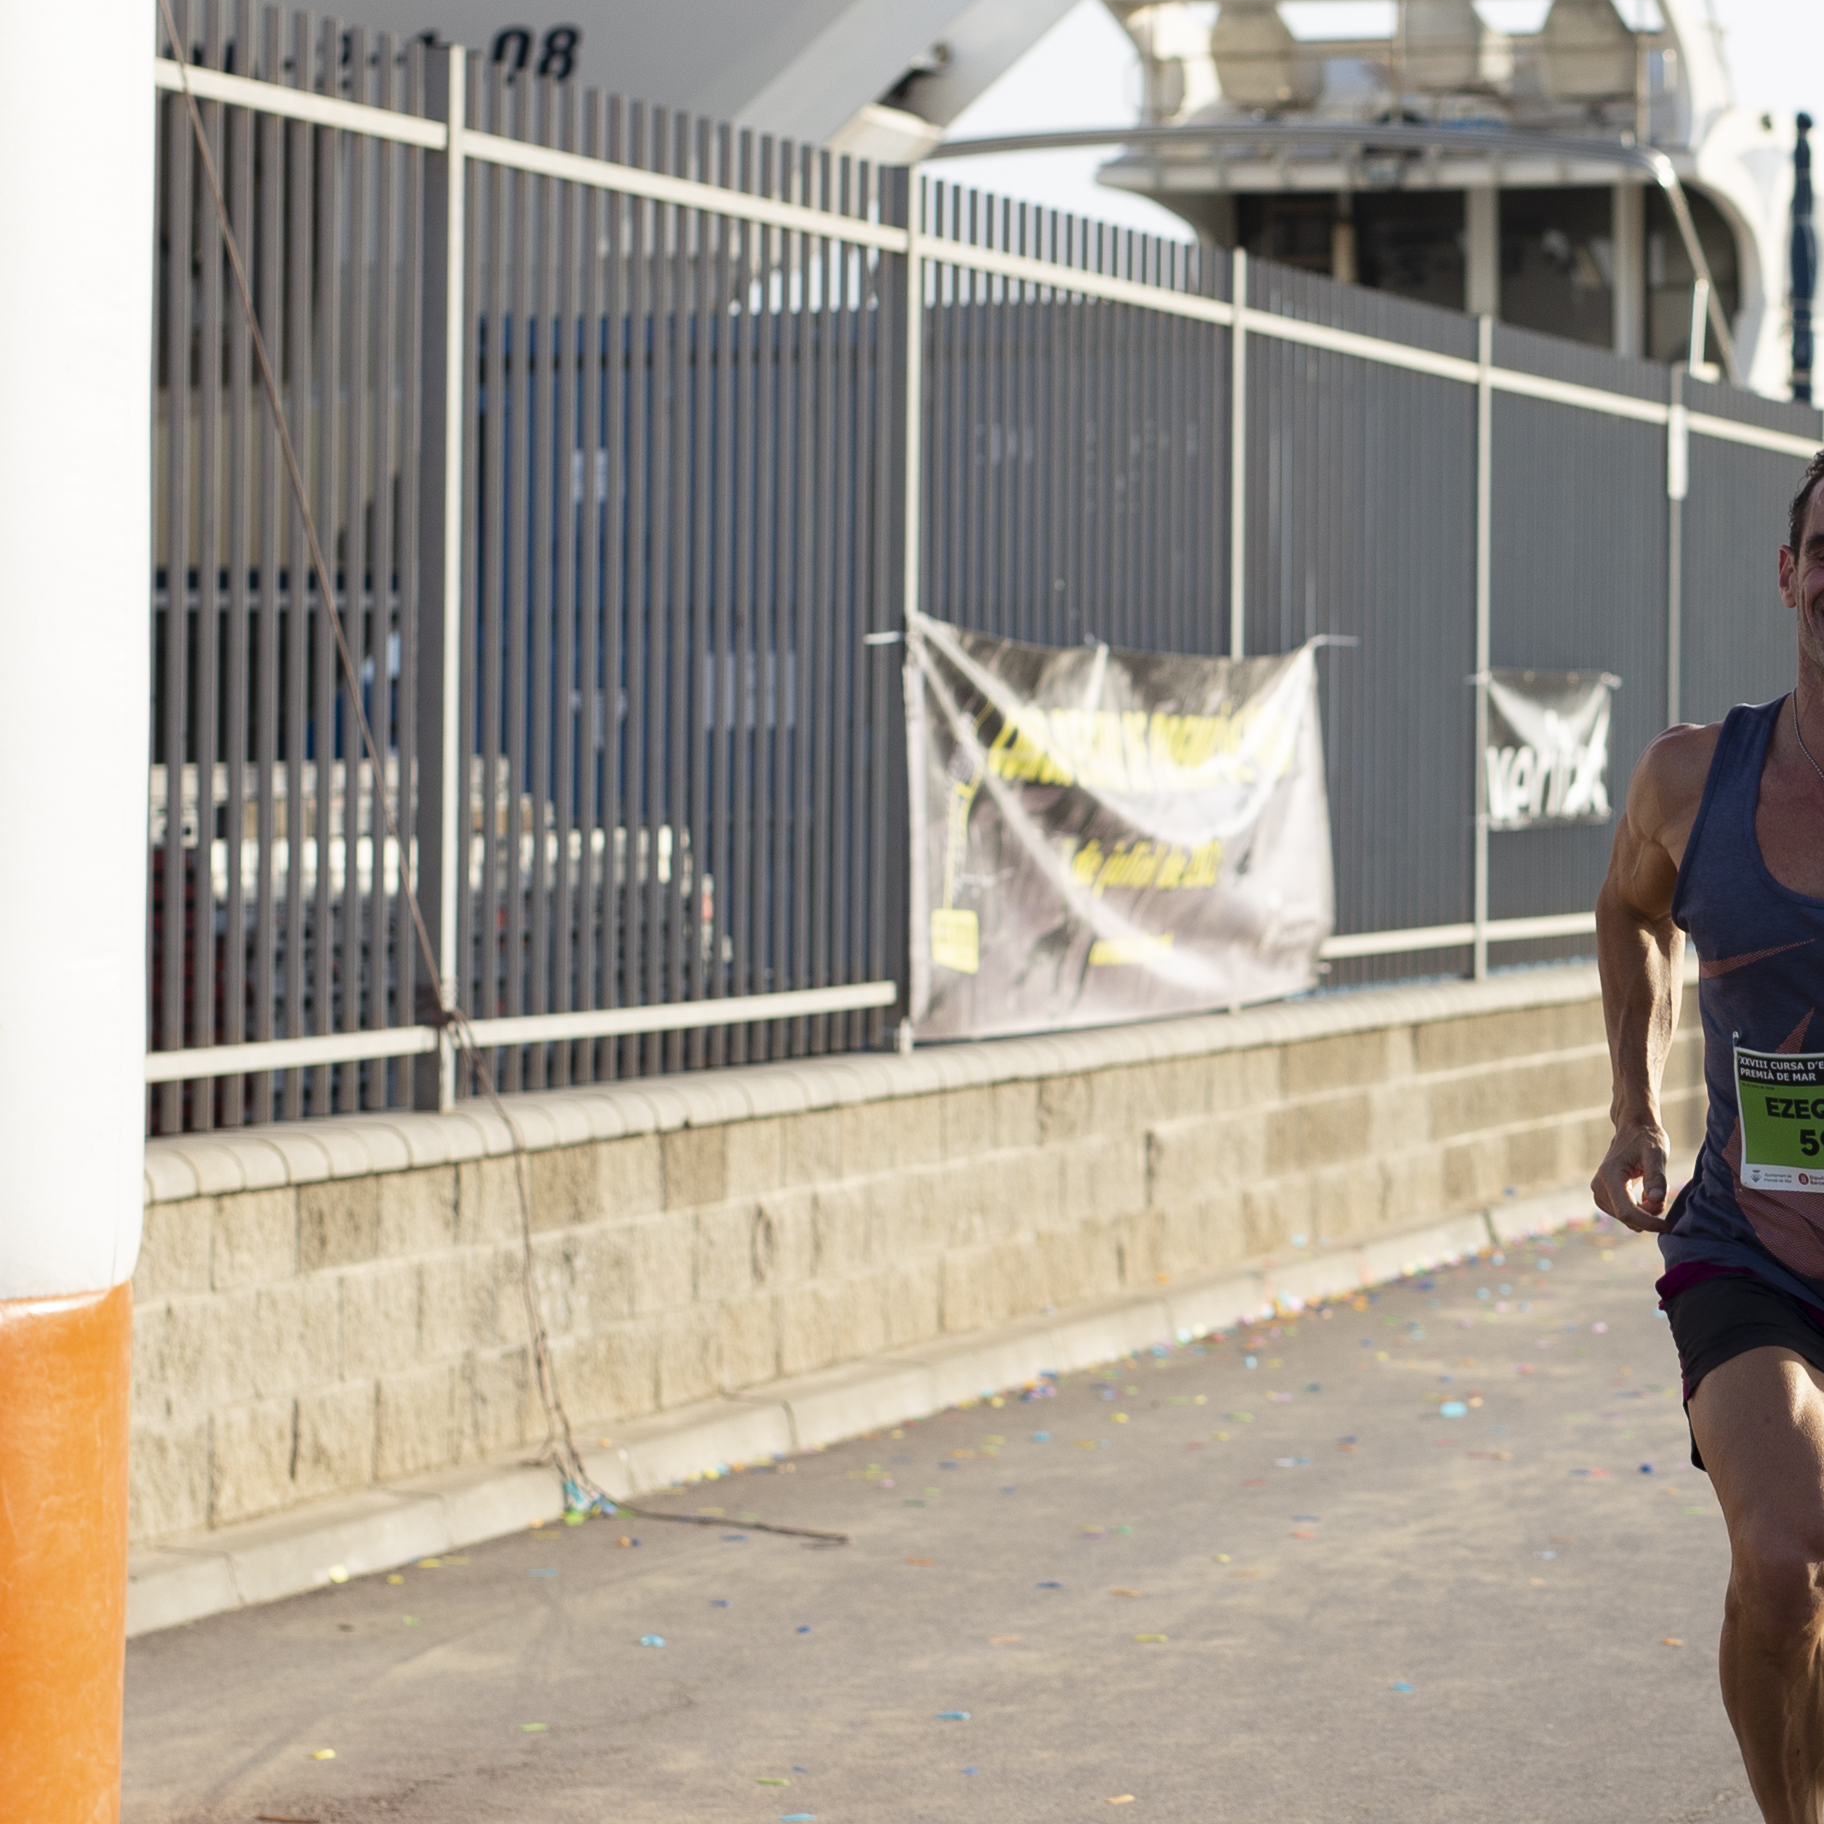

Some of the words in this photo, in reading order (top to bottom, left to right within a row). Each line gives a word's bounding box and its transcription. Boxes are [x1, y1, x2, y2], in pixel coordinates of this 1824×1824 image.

[1740, 1056, 1768, 1069] XXVIII
[1770, 1061, 1805, 1071] CURSA
[1740, 1067, 1774, 1080] PREMIÀ
[1776, 1072, 1790, 1081] DE
[1792, 1072, 1816, 1081] MAR
